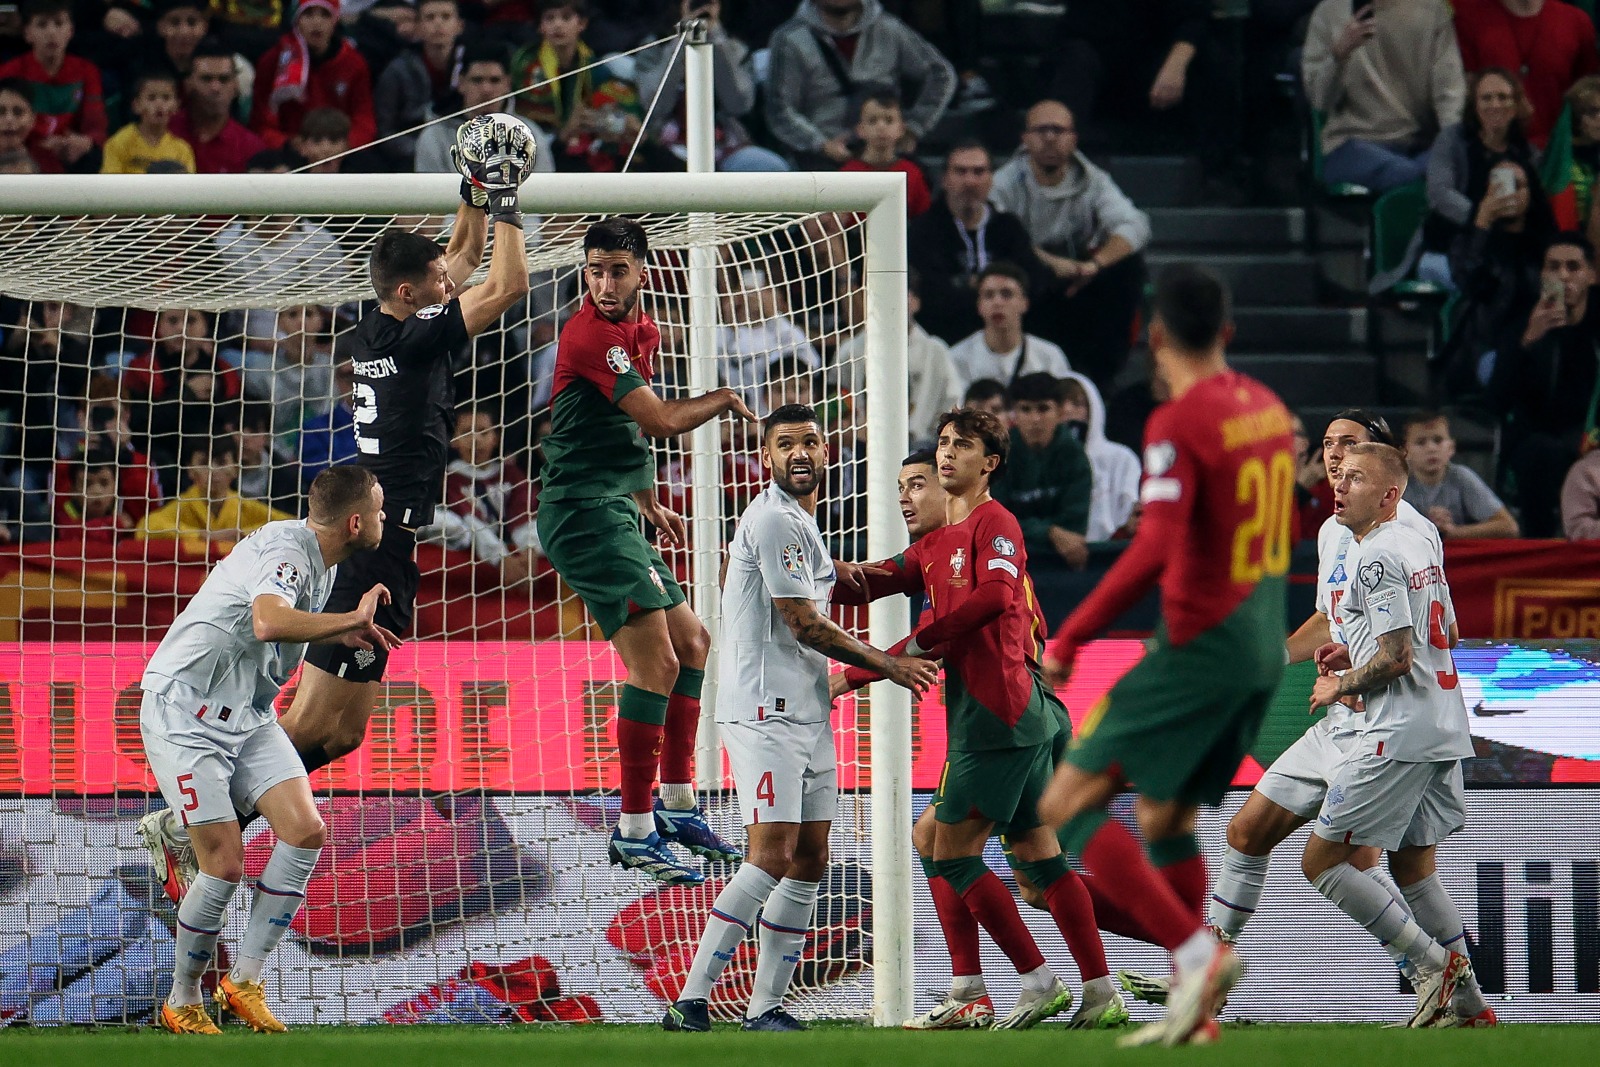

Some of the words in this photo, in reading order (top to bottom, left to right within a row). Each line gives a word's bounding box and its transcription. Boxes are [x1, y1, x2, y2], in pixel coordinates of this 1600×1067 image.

[501, 196, 516, 207] HV
[1230, 450, 1294, 584] 20
[1428, 599, 1459, 691] 9
[176, 773, 199, 811] 5
[756, 771, 775, 807] 4
